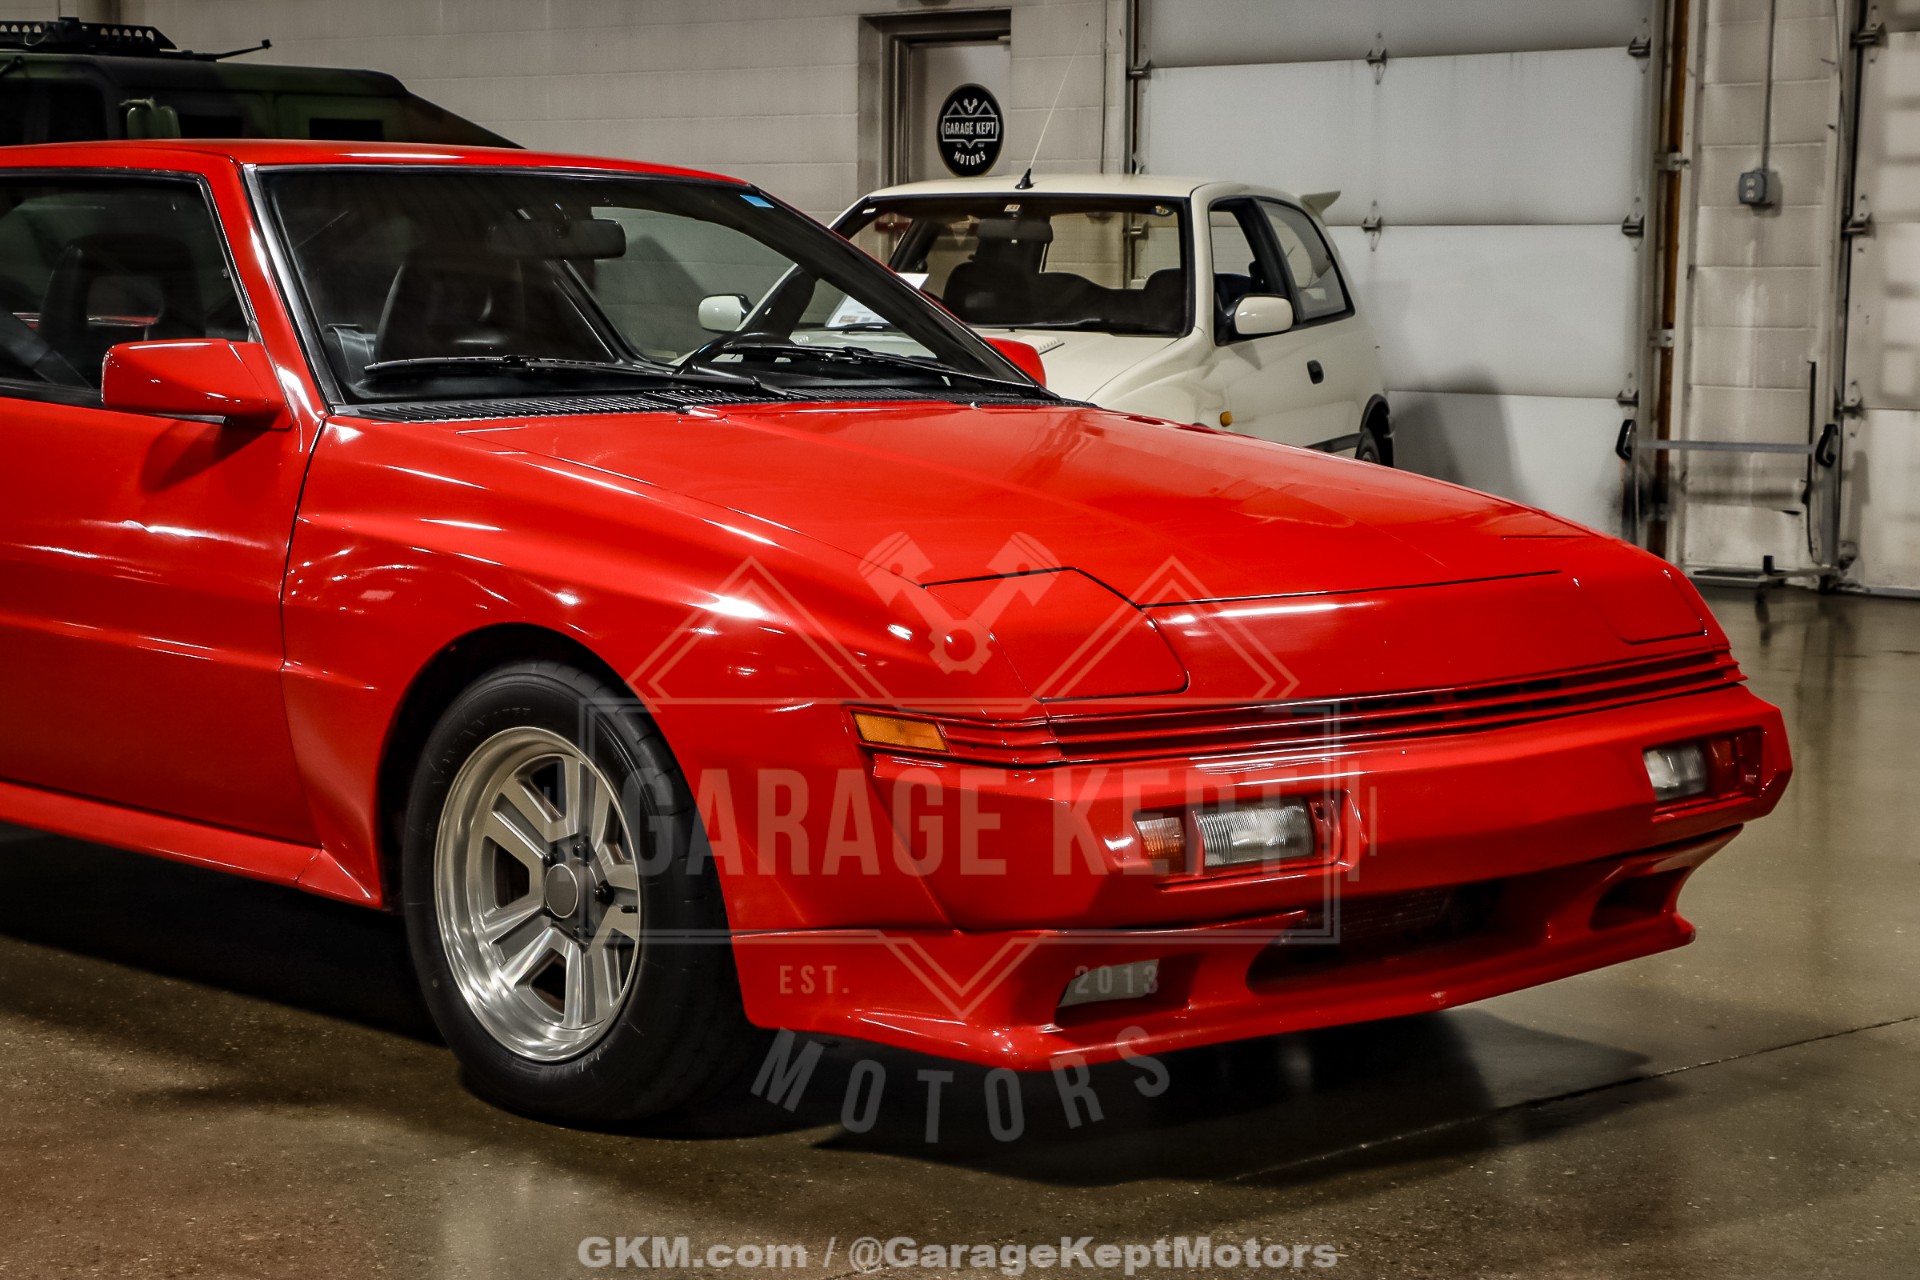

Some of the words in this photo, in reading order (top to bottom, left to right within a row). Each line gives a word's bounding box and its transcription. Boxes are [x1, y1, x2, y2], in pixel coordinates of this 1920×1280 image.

[945, 122, 974, 135] GARAGE
[976, 121, 995, 135] KEPT
[954, 150, 986, 166] MOTORS
